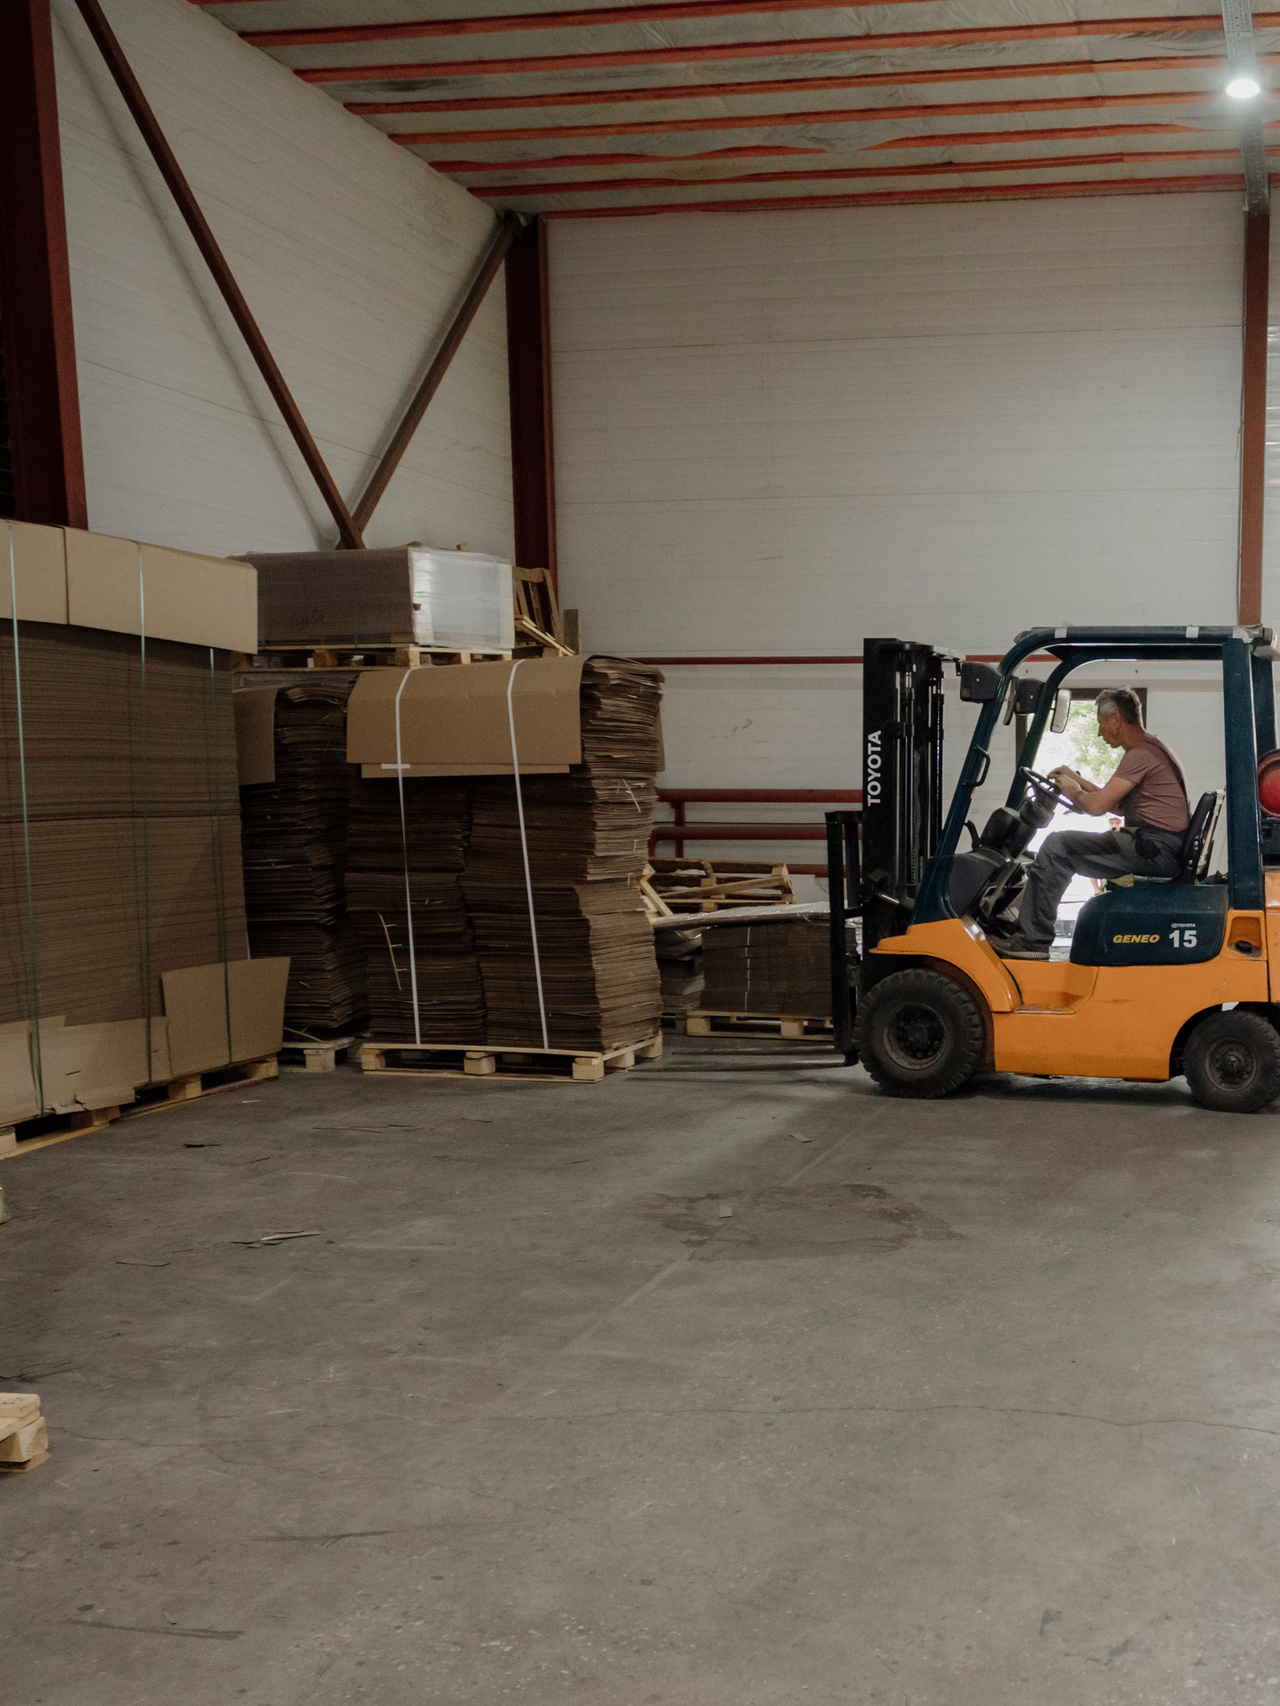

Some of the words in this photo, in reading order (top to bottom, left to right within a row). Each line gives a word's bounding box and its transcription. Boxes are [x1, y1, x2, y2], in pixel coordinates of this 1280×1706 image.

[867, 730, 881, 807] TOYOTA
[1112, 934, 1160, 944] GENEO
[1169, 929, 1198, 948] 15
